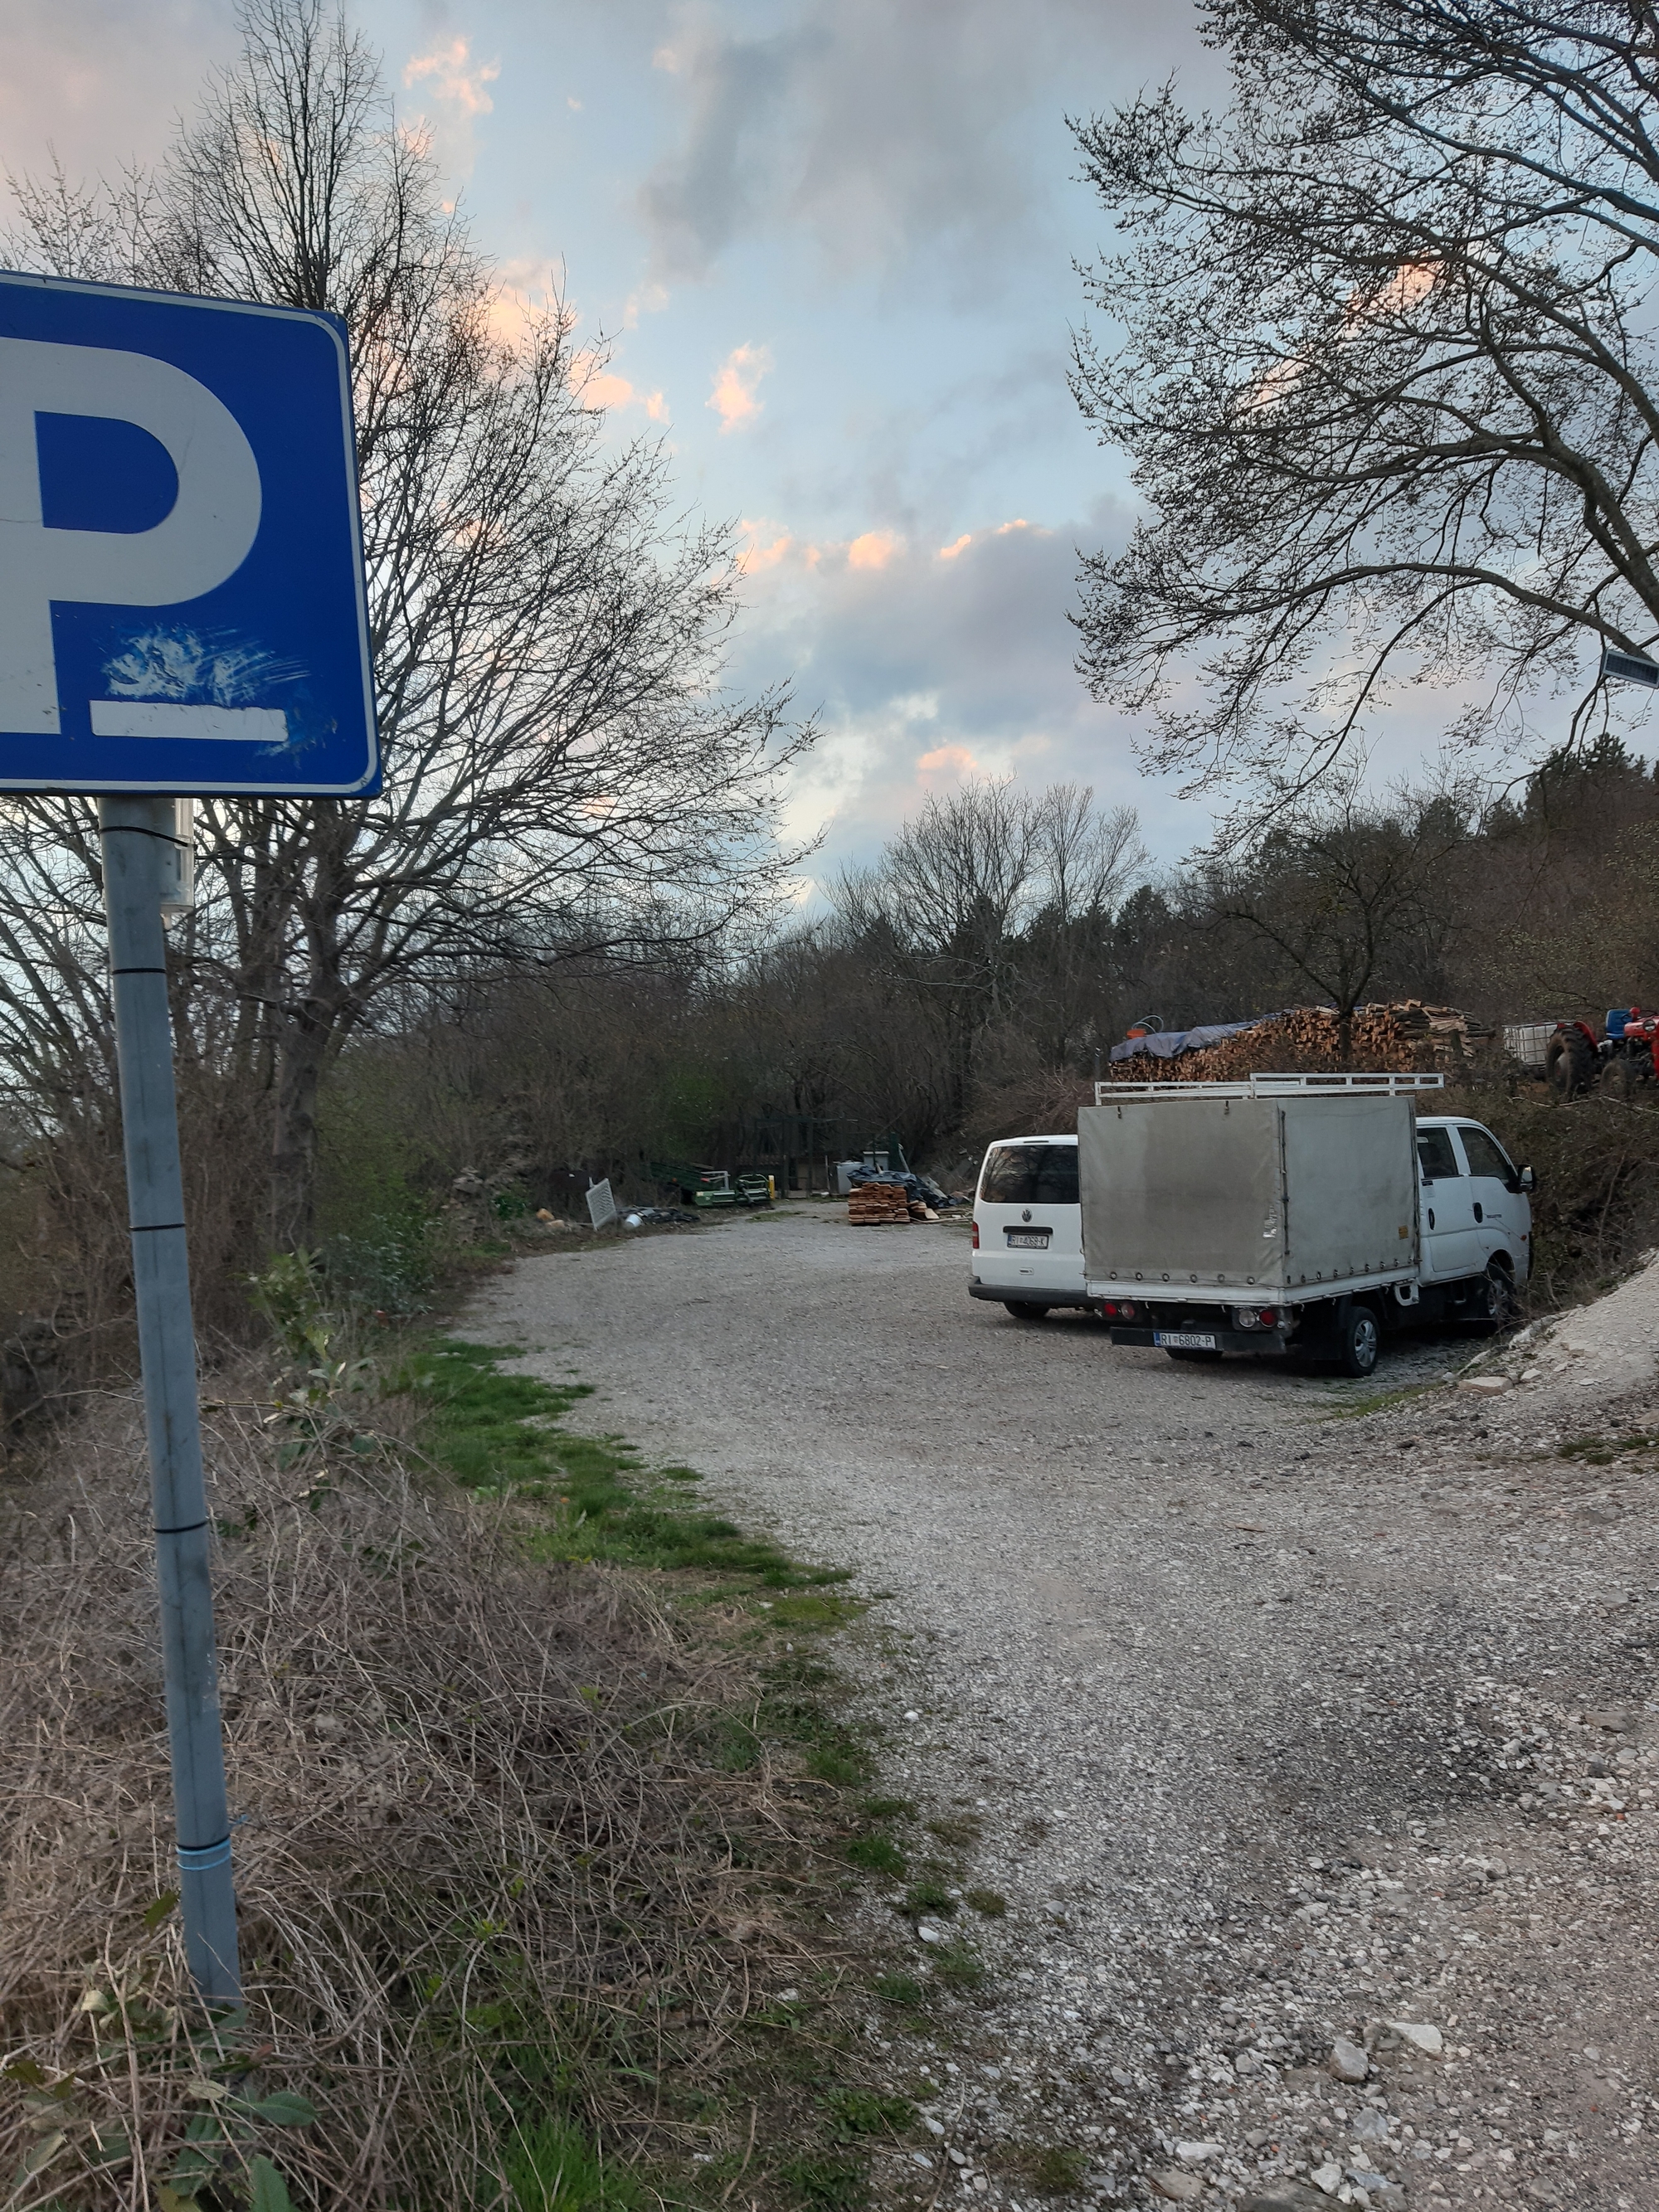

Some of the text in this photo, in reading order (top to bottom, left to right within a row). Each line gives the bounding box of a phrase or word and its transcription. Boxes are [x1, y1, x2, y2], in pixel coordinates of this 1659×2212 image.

[0, 337, 263, 737] P
[1160, 1334, 1212, 1347] RI 6802-P
